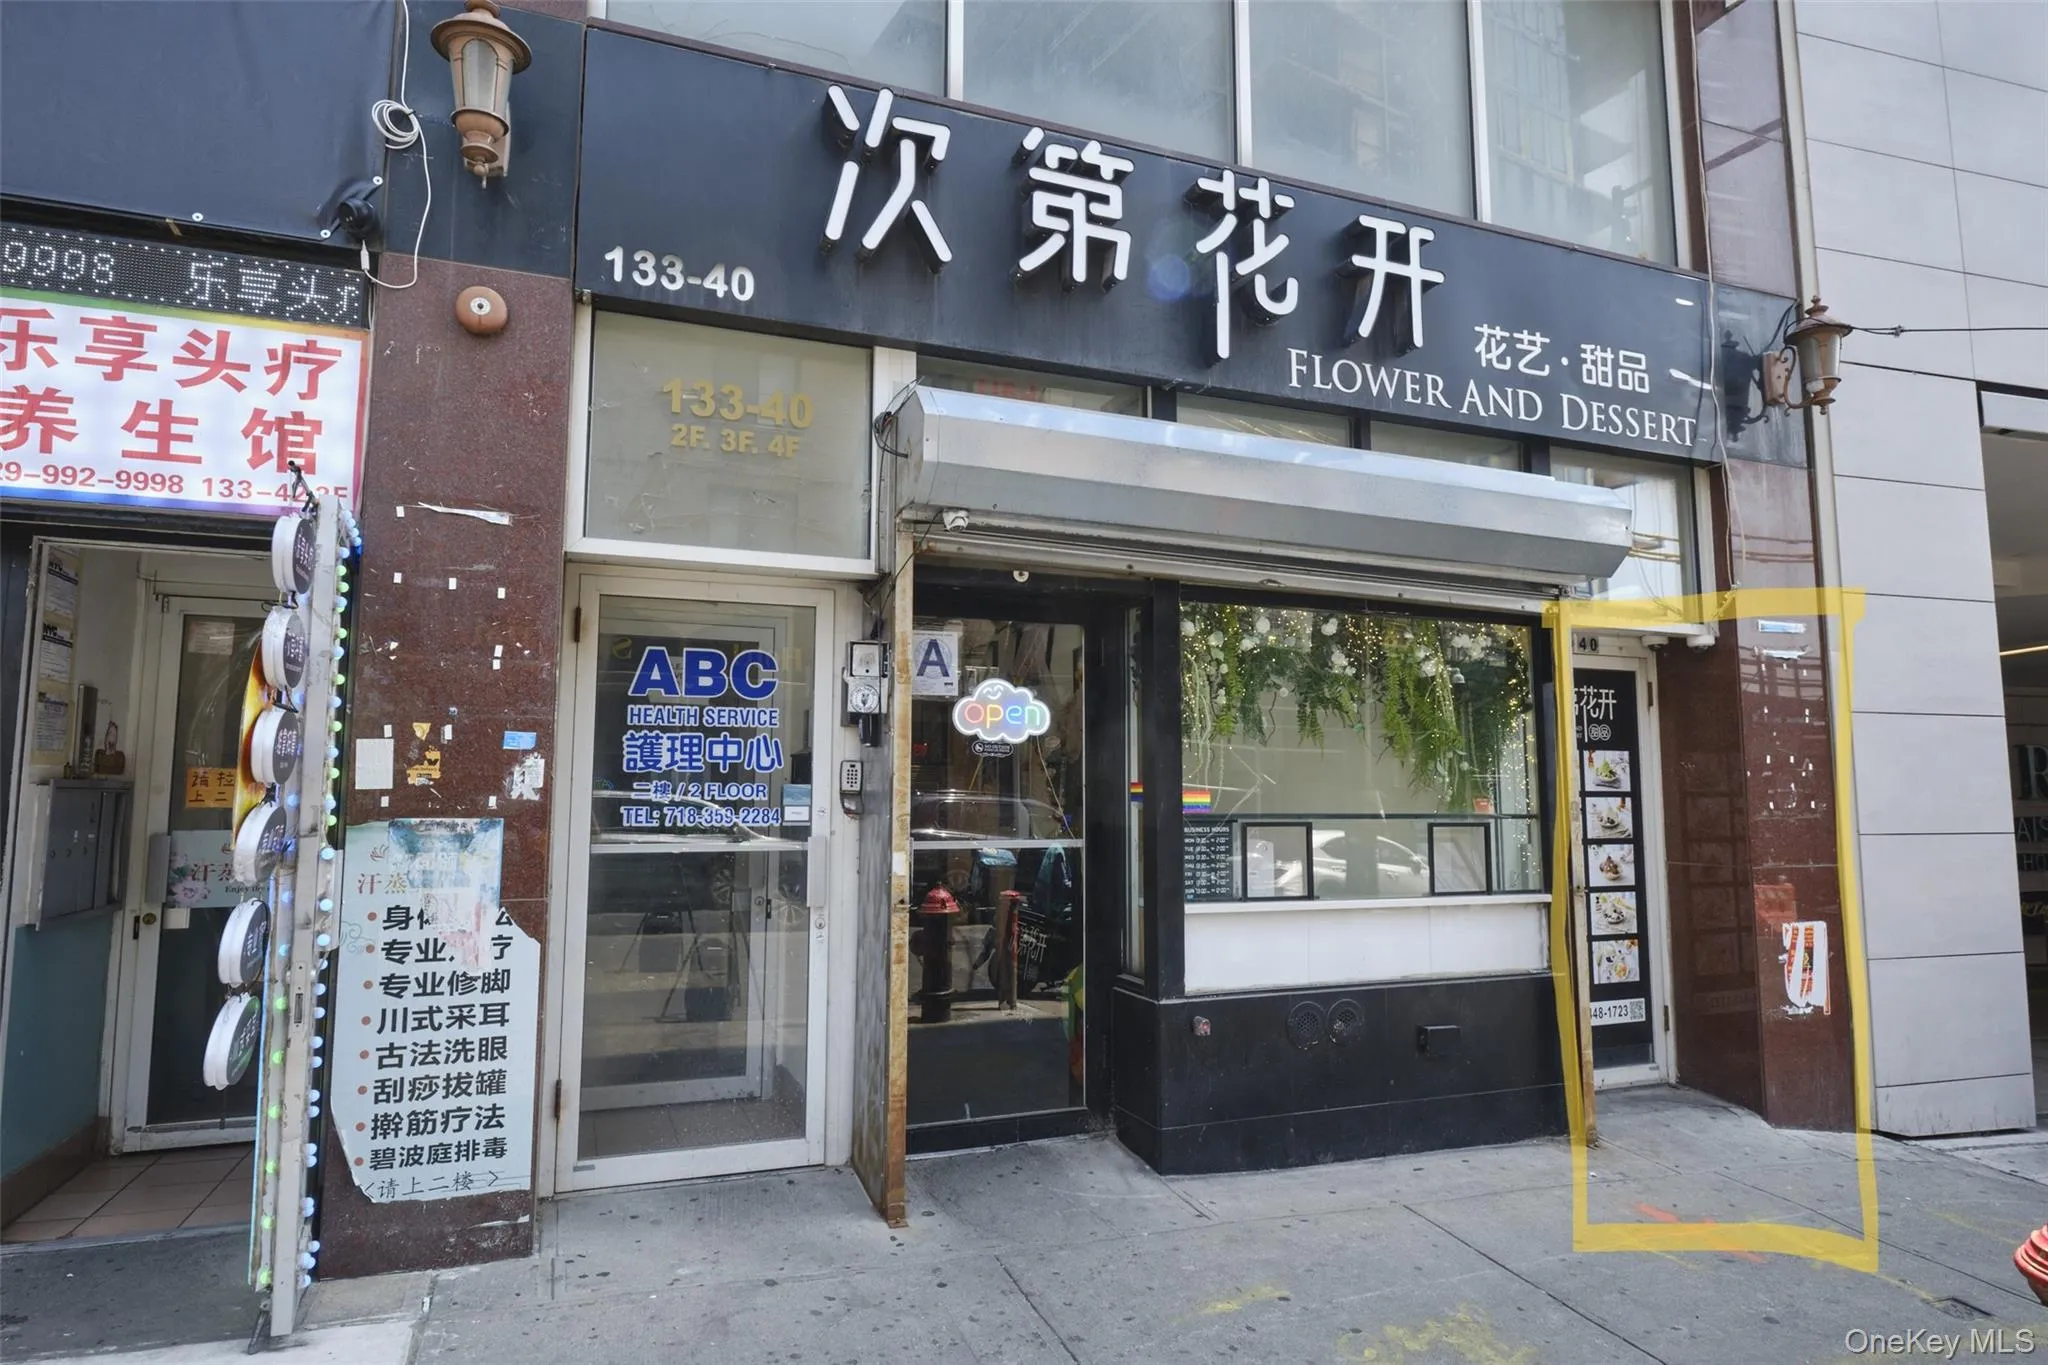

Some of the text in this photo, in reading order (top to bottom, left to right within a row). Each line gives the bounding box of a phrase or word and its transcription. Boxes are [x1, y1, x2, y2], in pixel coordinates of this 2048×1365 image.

[824, 84, 1445, 360] 次第花开
[604, 246, 755, 302] 133-40
[662, 378, 814, 429] 133-40
[1288, 347, 1698, 447] FLOWER AND DESSERT
[0, 386, 323, 473] 养生馆
[0, 461, 184, 494] 9-992-9998
[628, 645, 779, 700] ABC
[917, 638, 950, 677] A
[628, 705, 780, 727] HEALTH SERVICE
[964, 702, 1041, 729] open
[622, 731, 784, 774] 護理中心
[631, 781, 673, 802] 二樓
[689, 783, 702, 799] 2
[704, 783, 768, 801] FLOOR
[622, 806, 781, 828] TEL: 718-359-2284
[378, 968, 512, 999] 专业修脚
[376, 1001, 511, 1035] 川式采耳
[375, 1036, 509, 1070] 古法洗眼
[372, 1069, 508, 1105] 刮痧拔罐
[369, 1137, 508, 1171] 碧波庭排毒
